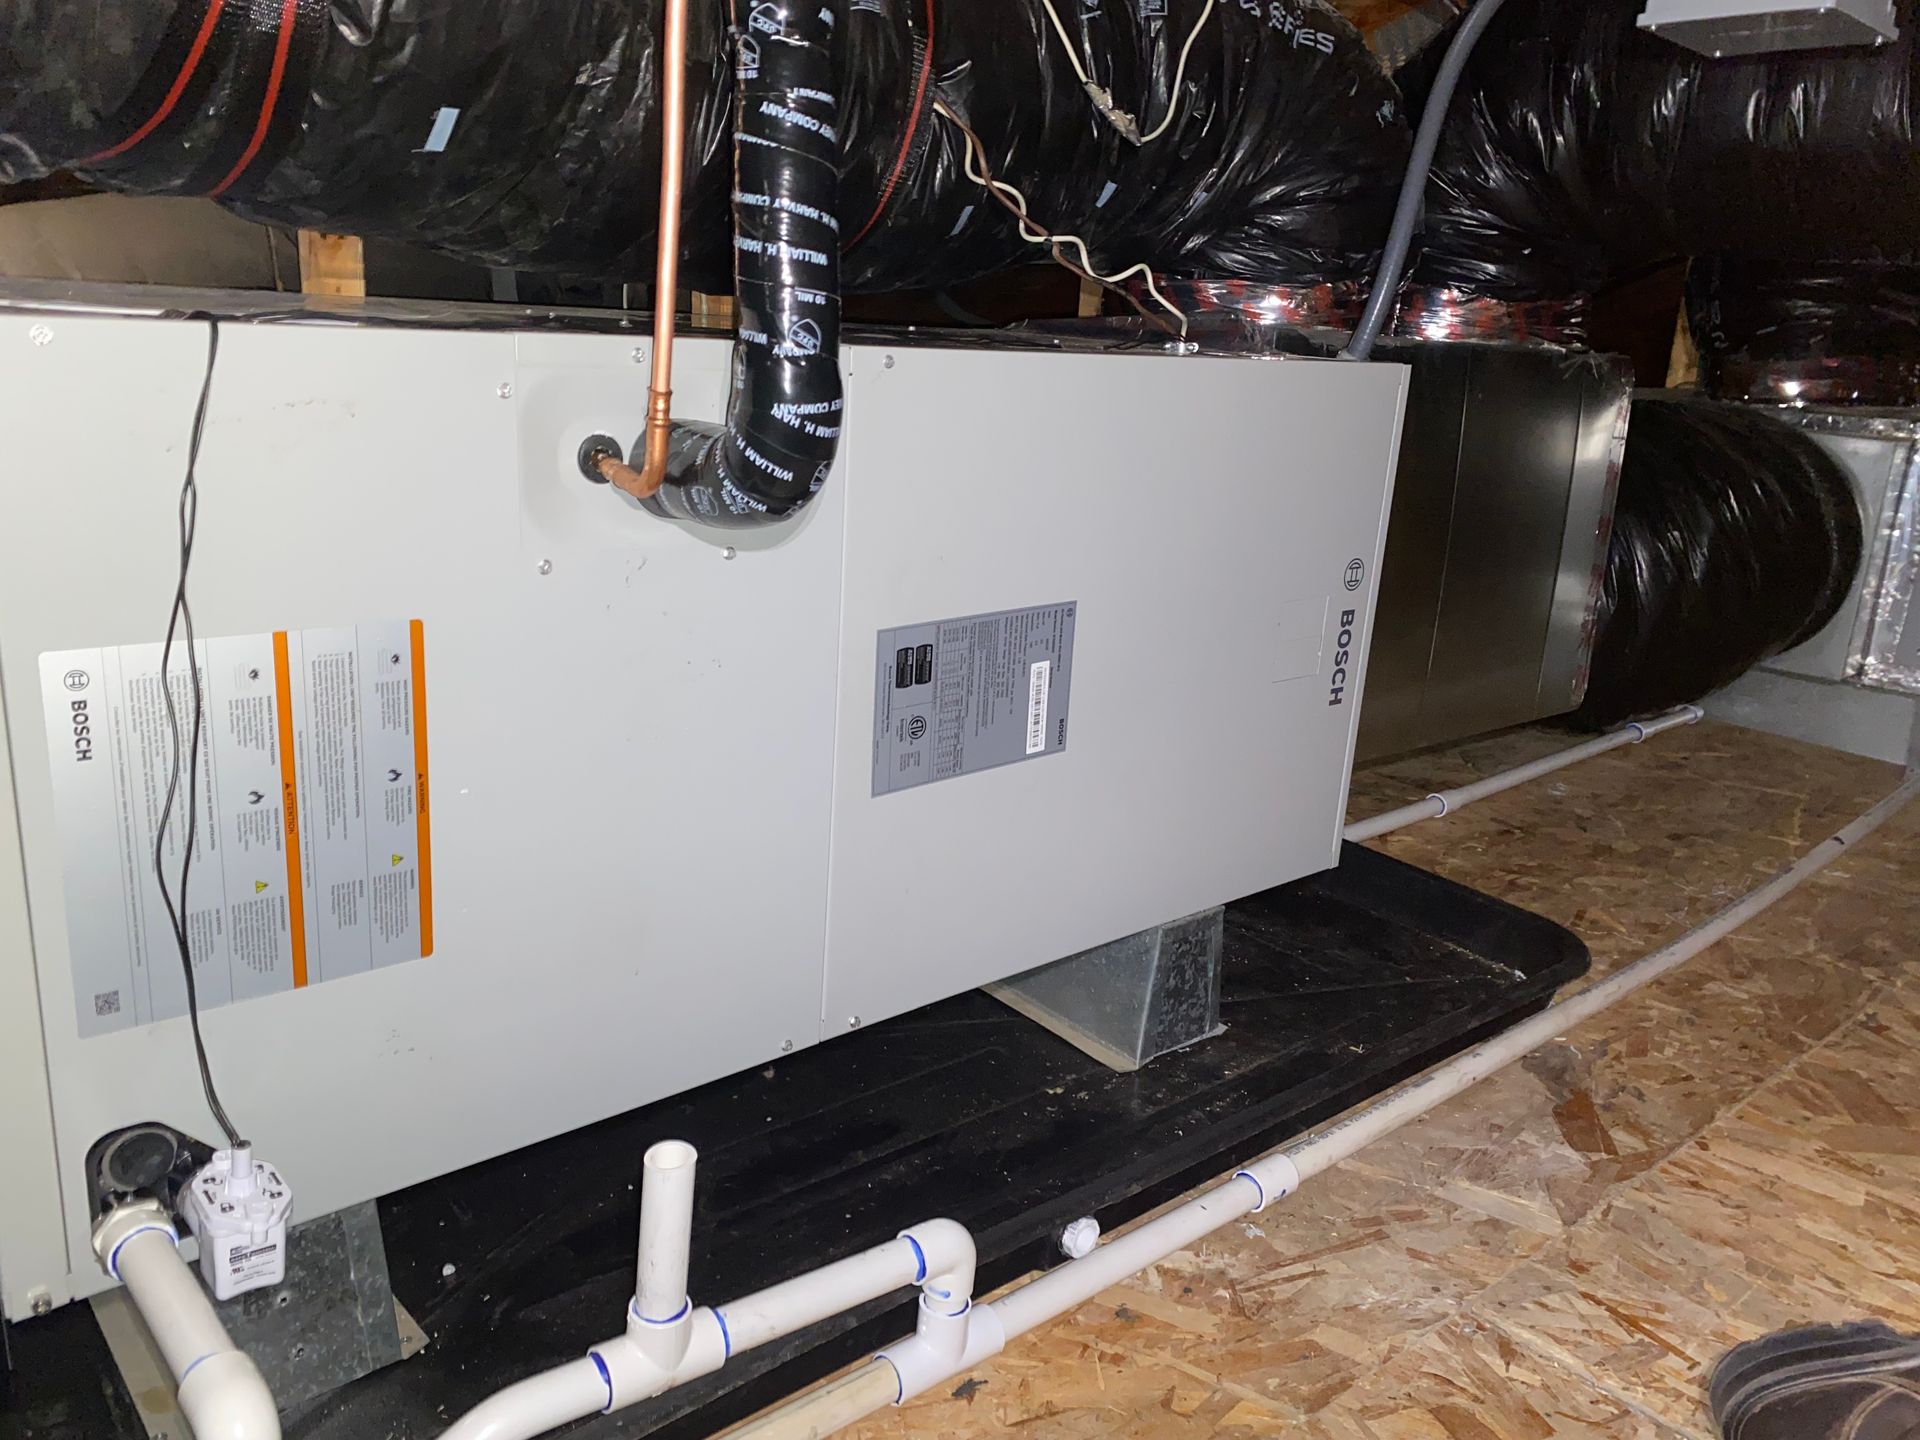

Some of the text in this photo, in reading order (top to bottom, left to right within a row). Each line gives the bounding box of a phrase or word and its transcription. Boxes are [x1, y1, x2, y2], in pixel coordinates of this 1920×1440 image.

[758, 100, 821, 131] COMPANY
[770, 401, 831, 417] COMPANY
[735, 432, 748, 451] H.
[803, 419, 816, 435] H.
[744, 446, 794, 483] WILLIAM
[722, 478, 769, 513] WILLIAM
[1328, 609, 1355, 706] BOSCH
[71, 699, 92, 761] BOSCH
[285, 791, 295, 834] ATTENTION
